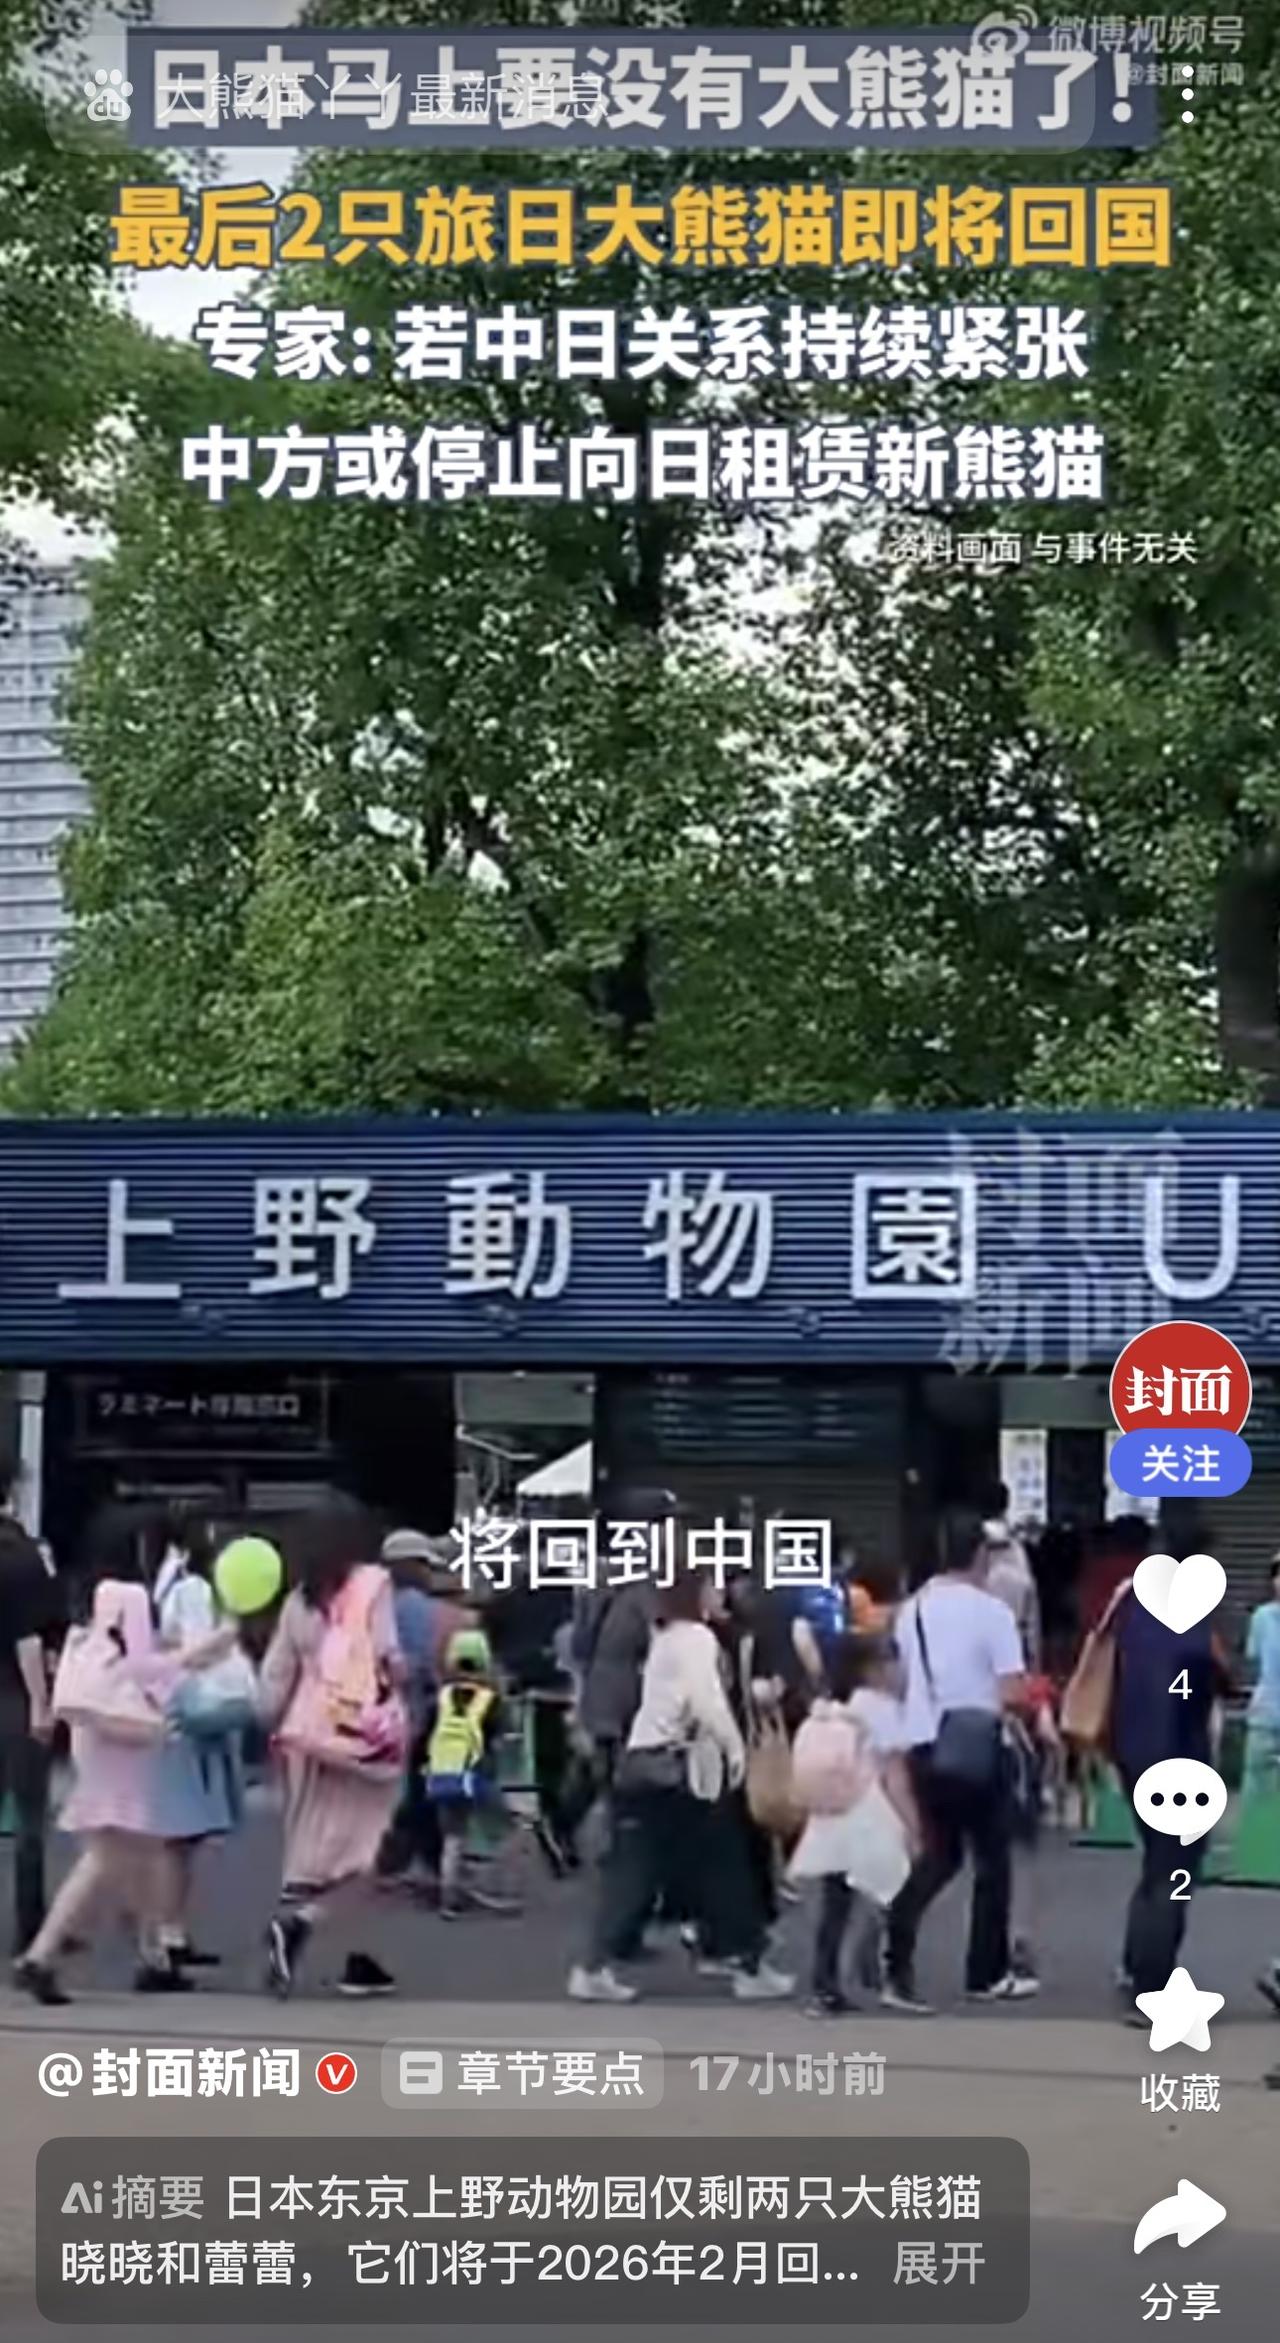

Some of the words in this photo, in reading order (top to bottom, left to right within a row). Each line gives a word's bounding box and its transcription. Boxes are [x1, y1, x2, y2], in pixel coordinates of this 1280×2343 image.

[58, 1169, 978, 1301] 上野動物園
